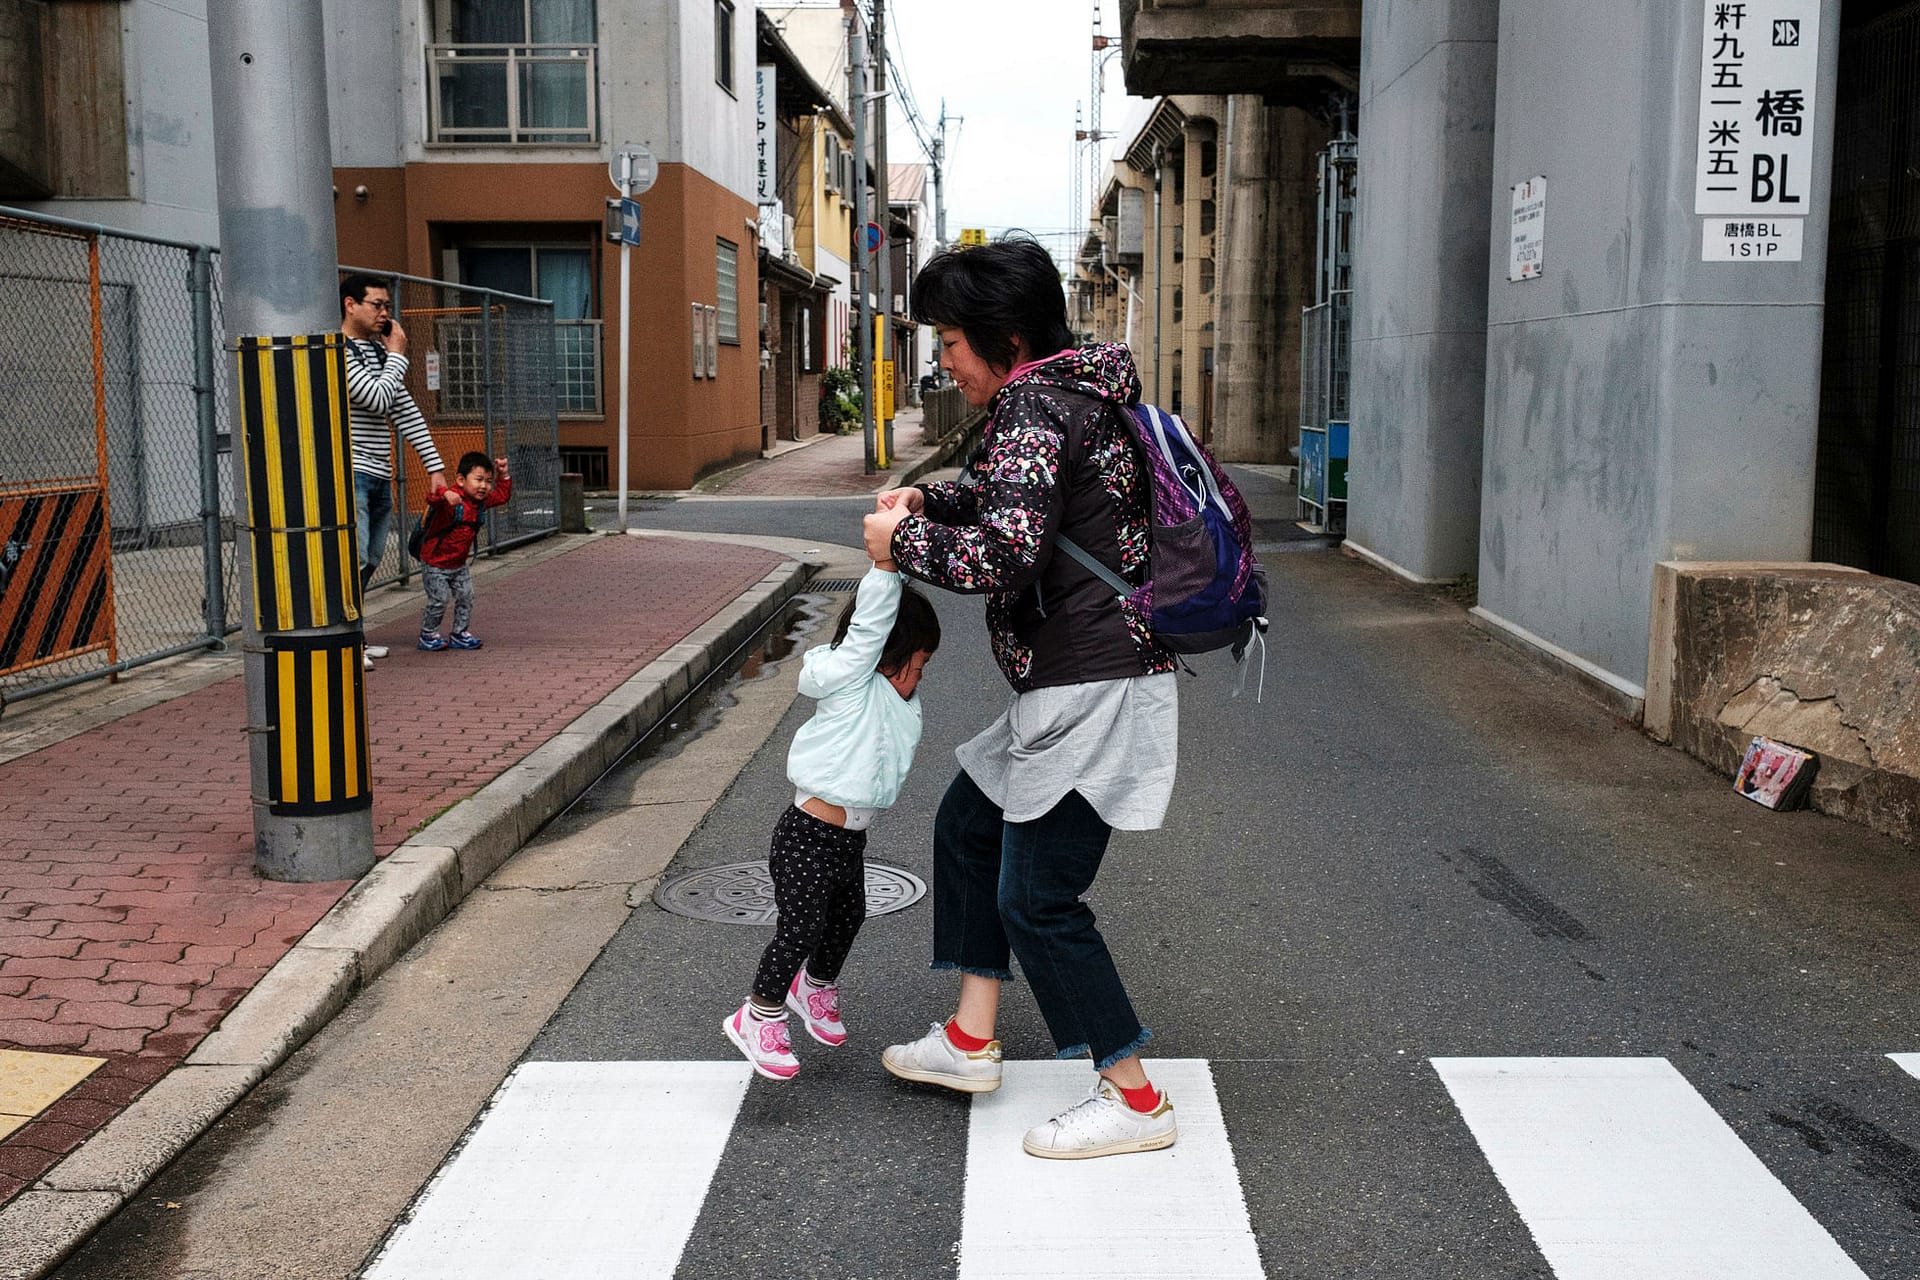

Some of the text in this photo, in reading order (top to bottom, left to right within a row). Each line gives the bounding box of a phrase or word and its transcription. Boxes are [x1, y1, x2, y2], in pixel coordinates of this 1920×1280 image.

[1755, 89, 1805, 137] 橋
[1751, 153, 1801, 204] BL
[1729, 242, 1778, 257] 1S1P
